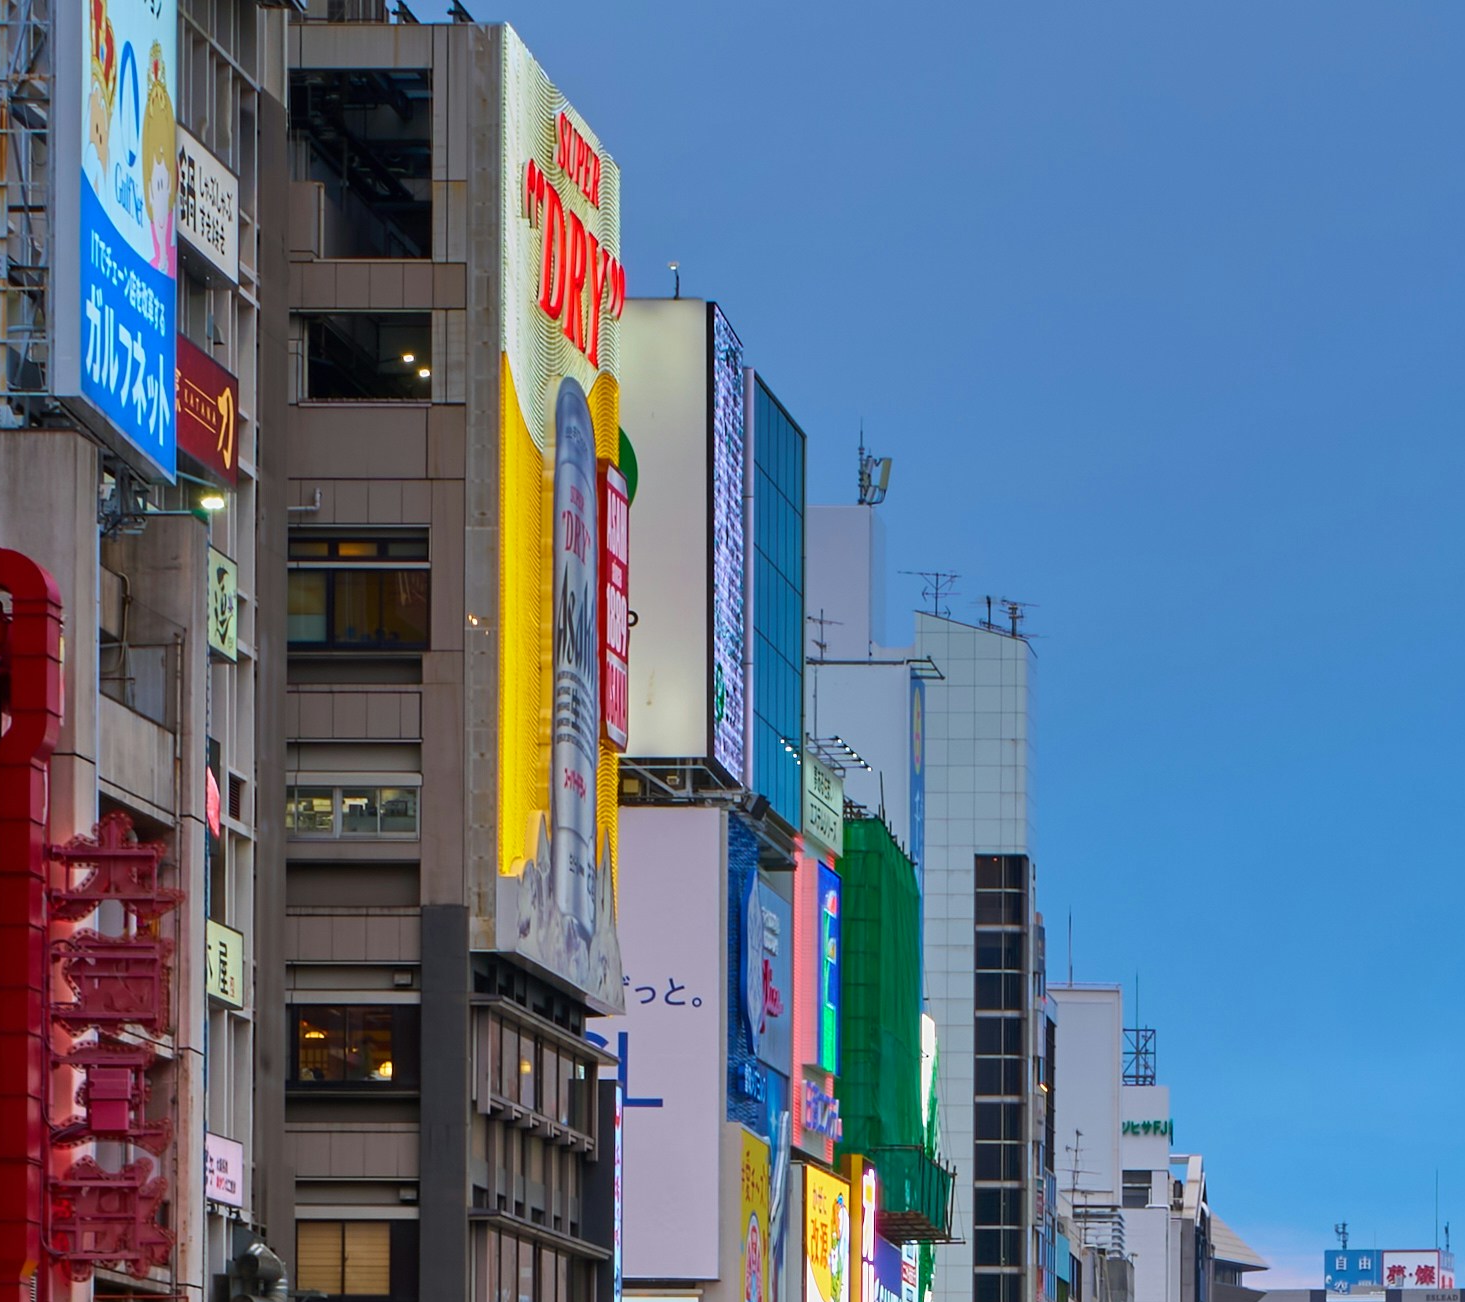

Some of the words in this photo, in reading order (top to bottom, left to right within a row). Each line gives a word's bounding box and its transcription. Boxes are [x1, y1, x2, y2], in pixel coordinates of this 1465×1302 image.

[556, 110, 600, 211] SUPER
[86, 282, 171, 447] ガルフネット
[606, 583, 629, 657] 1889
[623, 975, 703, 1009] っと。
